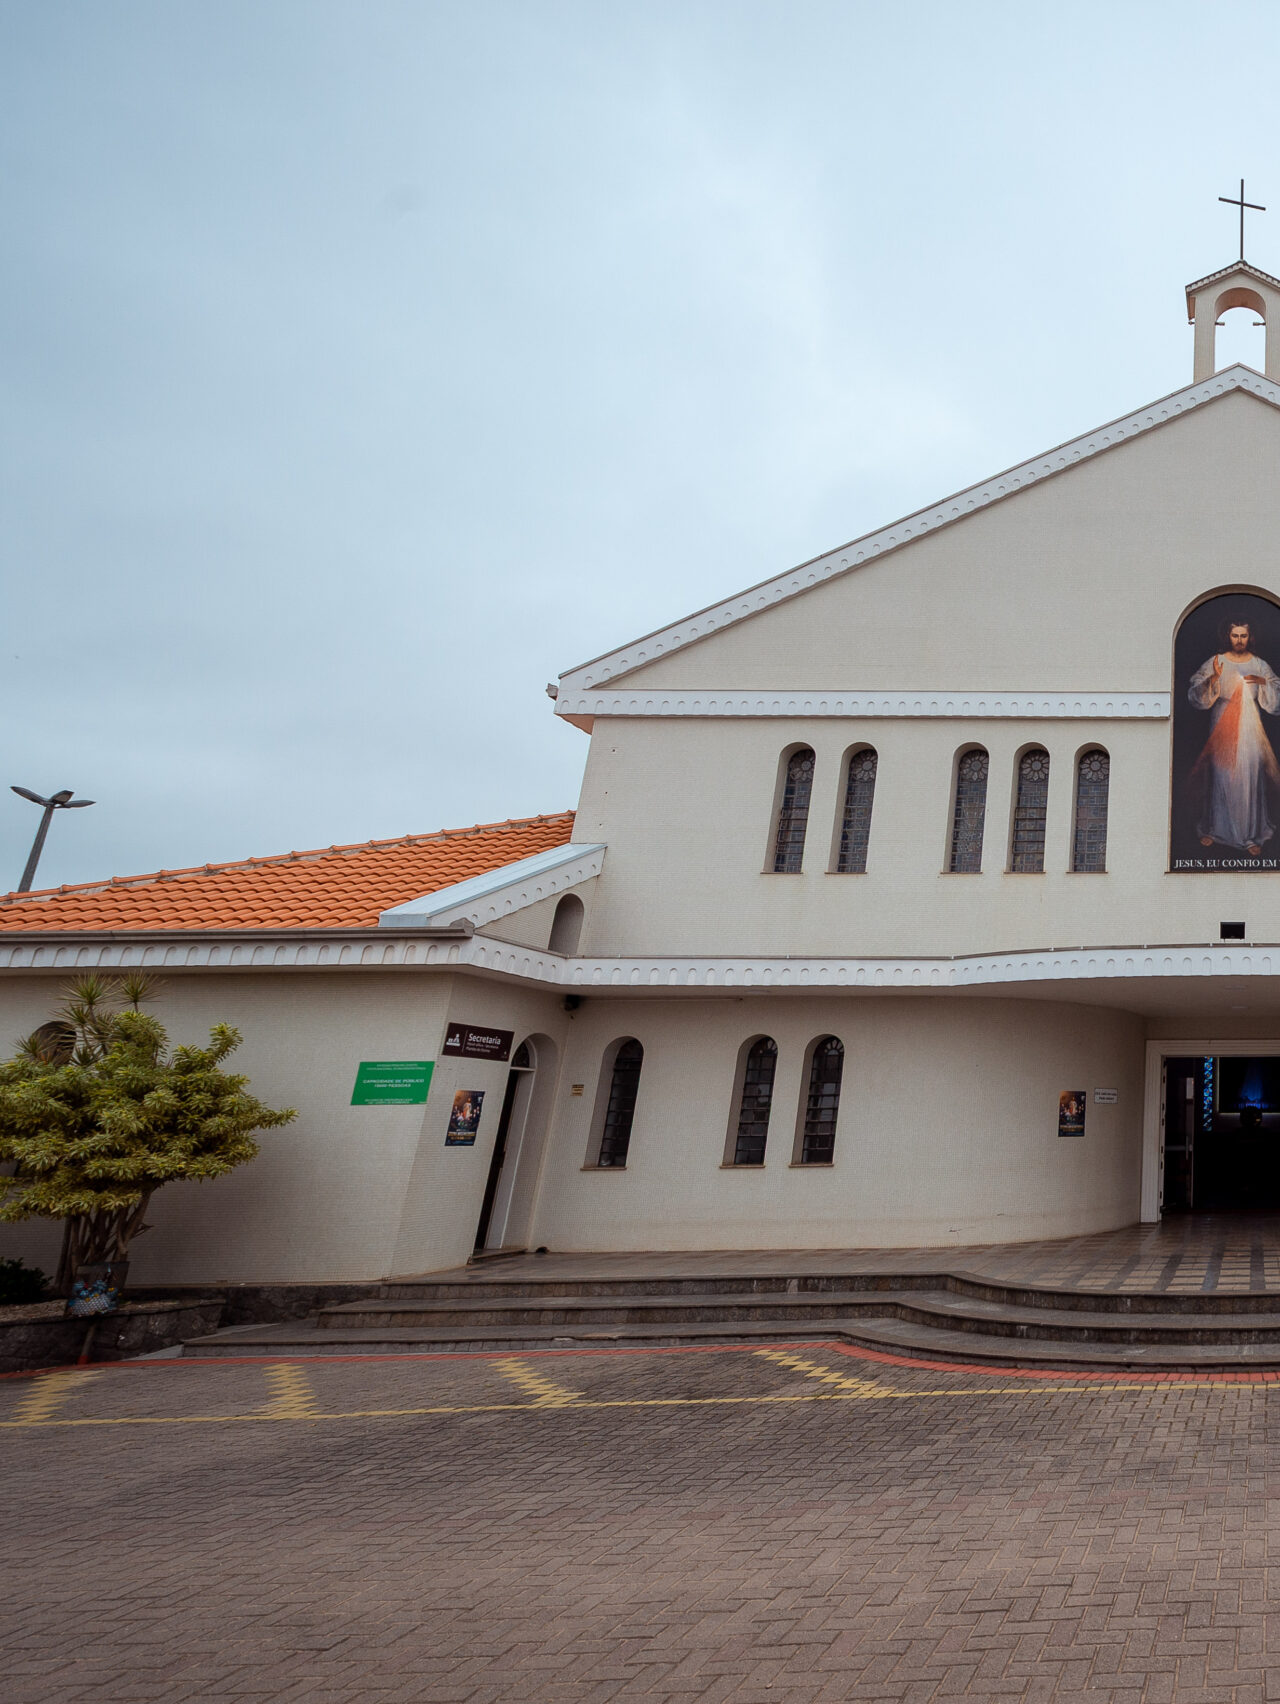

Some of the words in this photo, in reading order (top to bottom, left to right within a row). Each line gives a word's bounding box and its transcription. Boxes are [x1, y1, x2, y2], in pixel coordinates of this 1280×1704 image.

[1174, 859, 1205, 868] JESUS,
[1206, 859, 1220, 868] EU
[1222, 859, 1260, 868] CONFIO
[1262, 859, 1277, 868] EM
[468, 1033, 501, 1045] Secretaria
